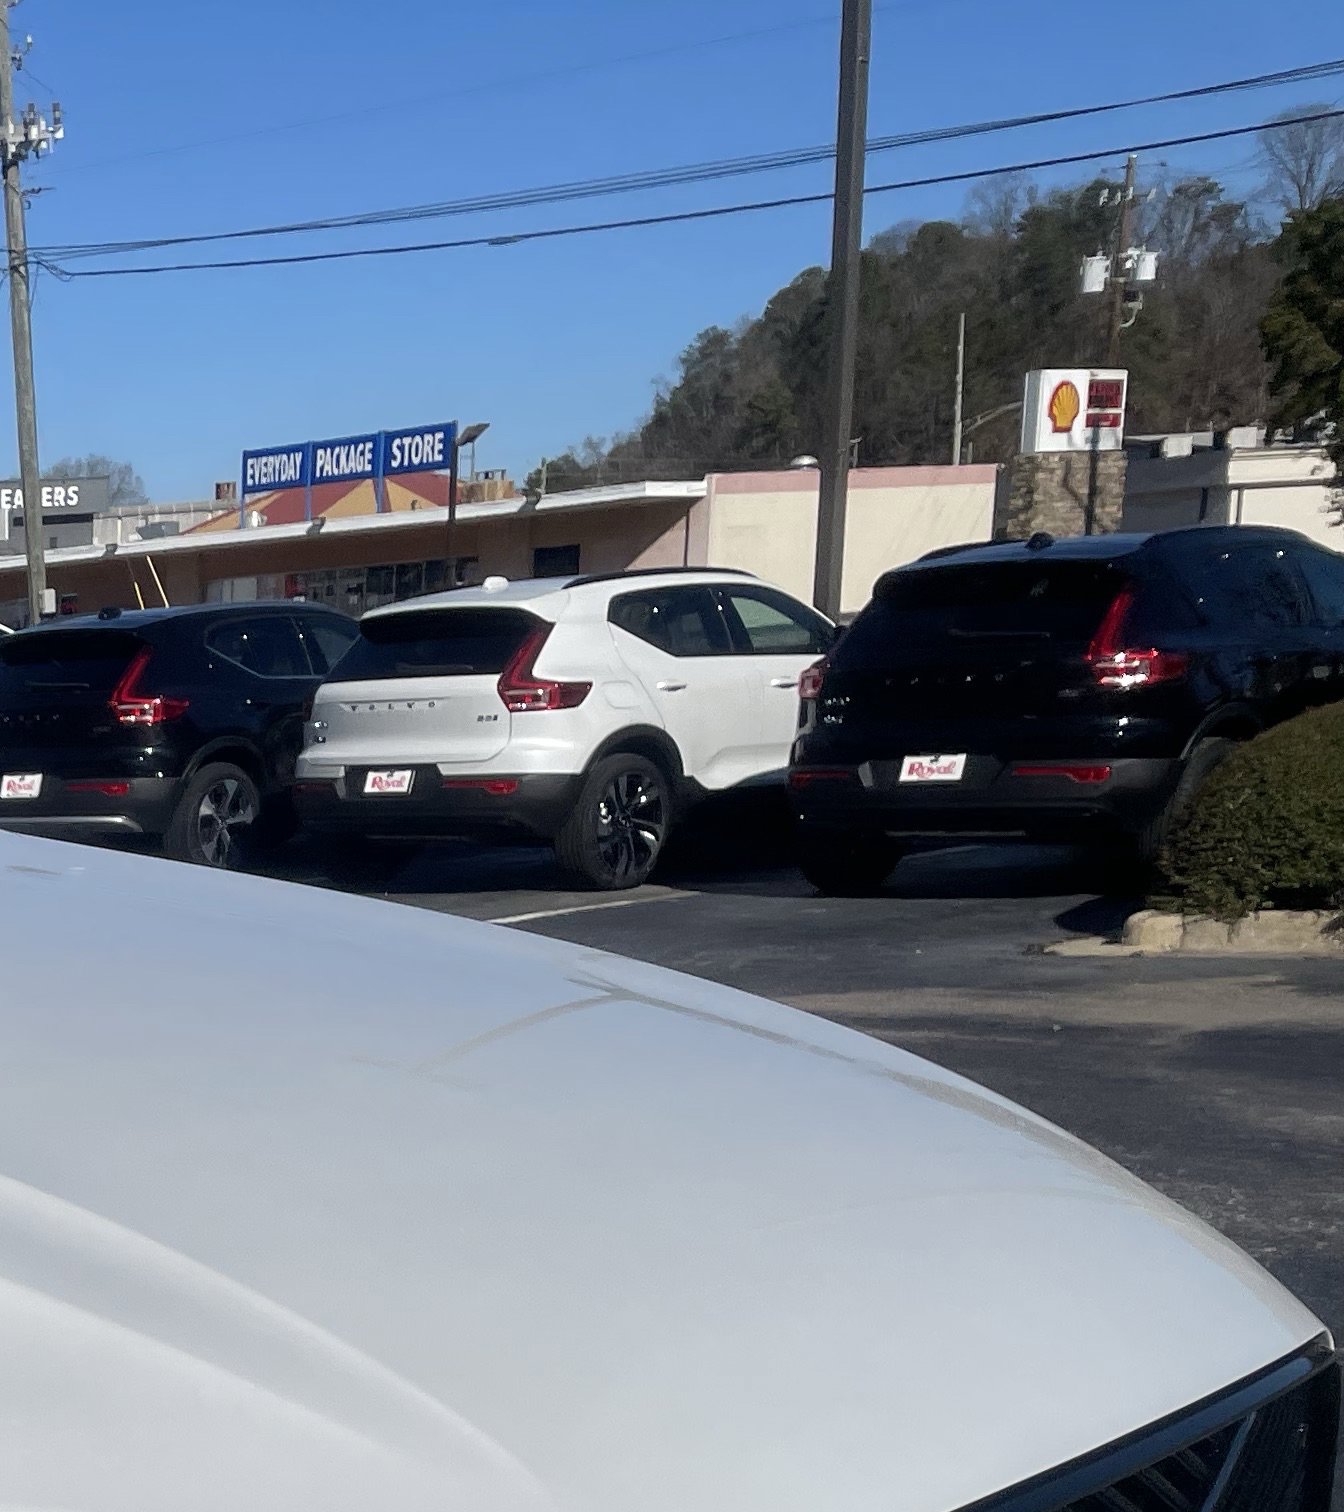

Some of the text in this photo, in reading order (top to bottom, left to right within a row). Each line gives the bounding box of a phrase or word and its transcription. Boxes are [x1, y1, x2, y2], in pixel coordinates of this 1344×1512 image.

[246, 431, 445, 487] EVERYDAY PACKAGE STORE
[907, 760, 957, 779] Royal
